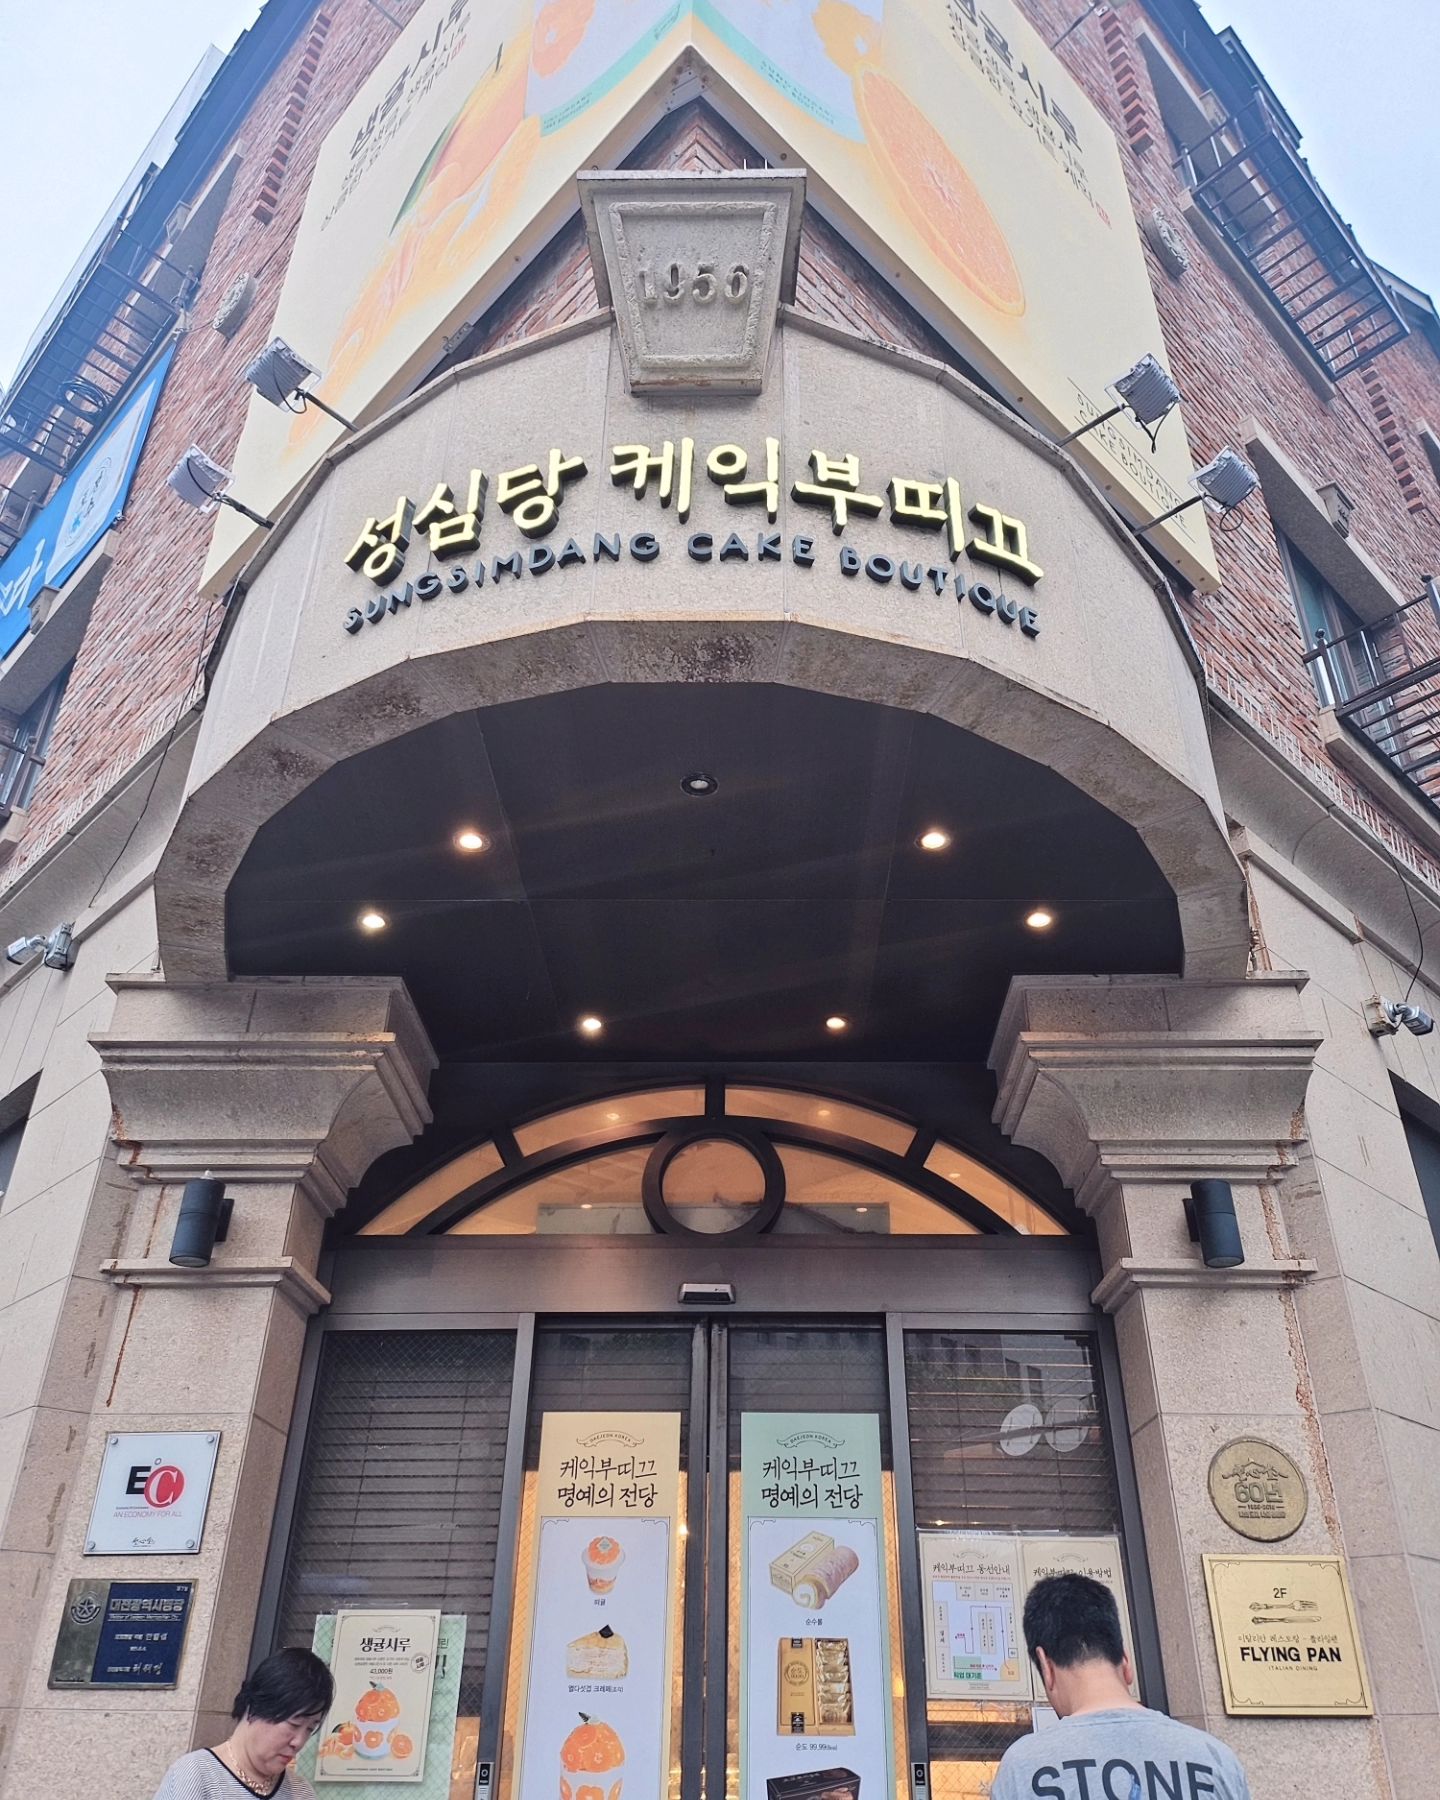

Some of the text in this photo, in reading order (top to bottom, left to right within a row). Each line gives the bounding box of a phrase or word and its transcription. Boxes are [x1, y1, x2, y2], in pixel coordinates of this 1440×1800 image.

[344, 447, 588, 587] 성심당
[343, 532, 1041, 639] SUNGSIMDANG CAKE BOUTIQUE
[559, 1455, 657, 1481] 케익부띠끄
[762, 1456, 861, 1482] 케익부띠끄
[557, 1482, 658, 1508] 명예의 전당
[761, 1483, 864, 1510] 명예의 전당
[1273, 1587, 1287, 1599] 2F
[359, 1637, 412, 1653] 생귤시루
[1239, 1646, 1342, 1663] FLYING PAN
[1031, 1759, 1215, 1800] STONE
